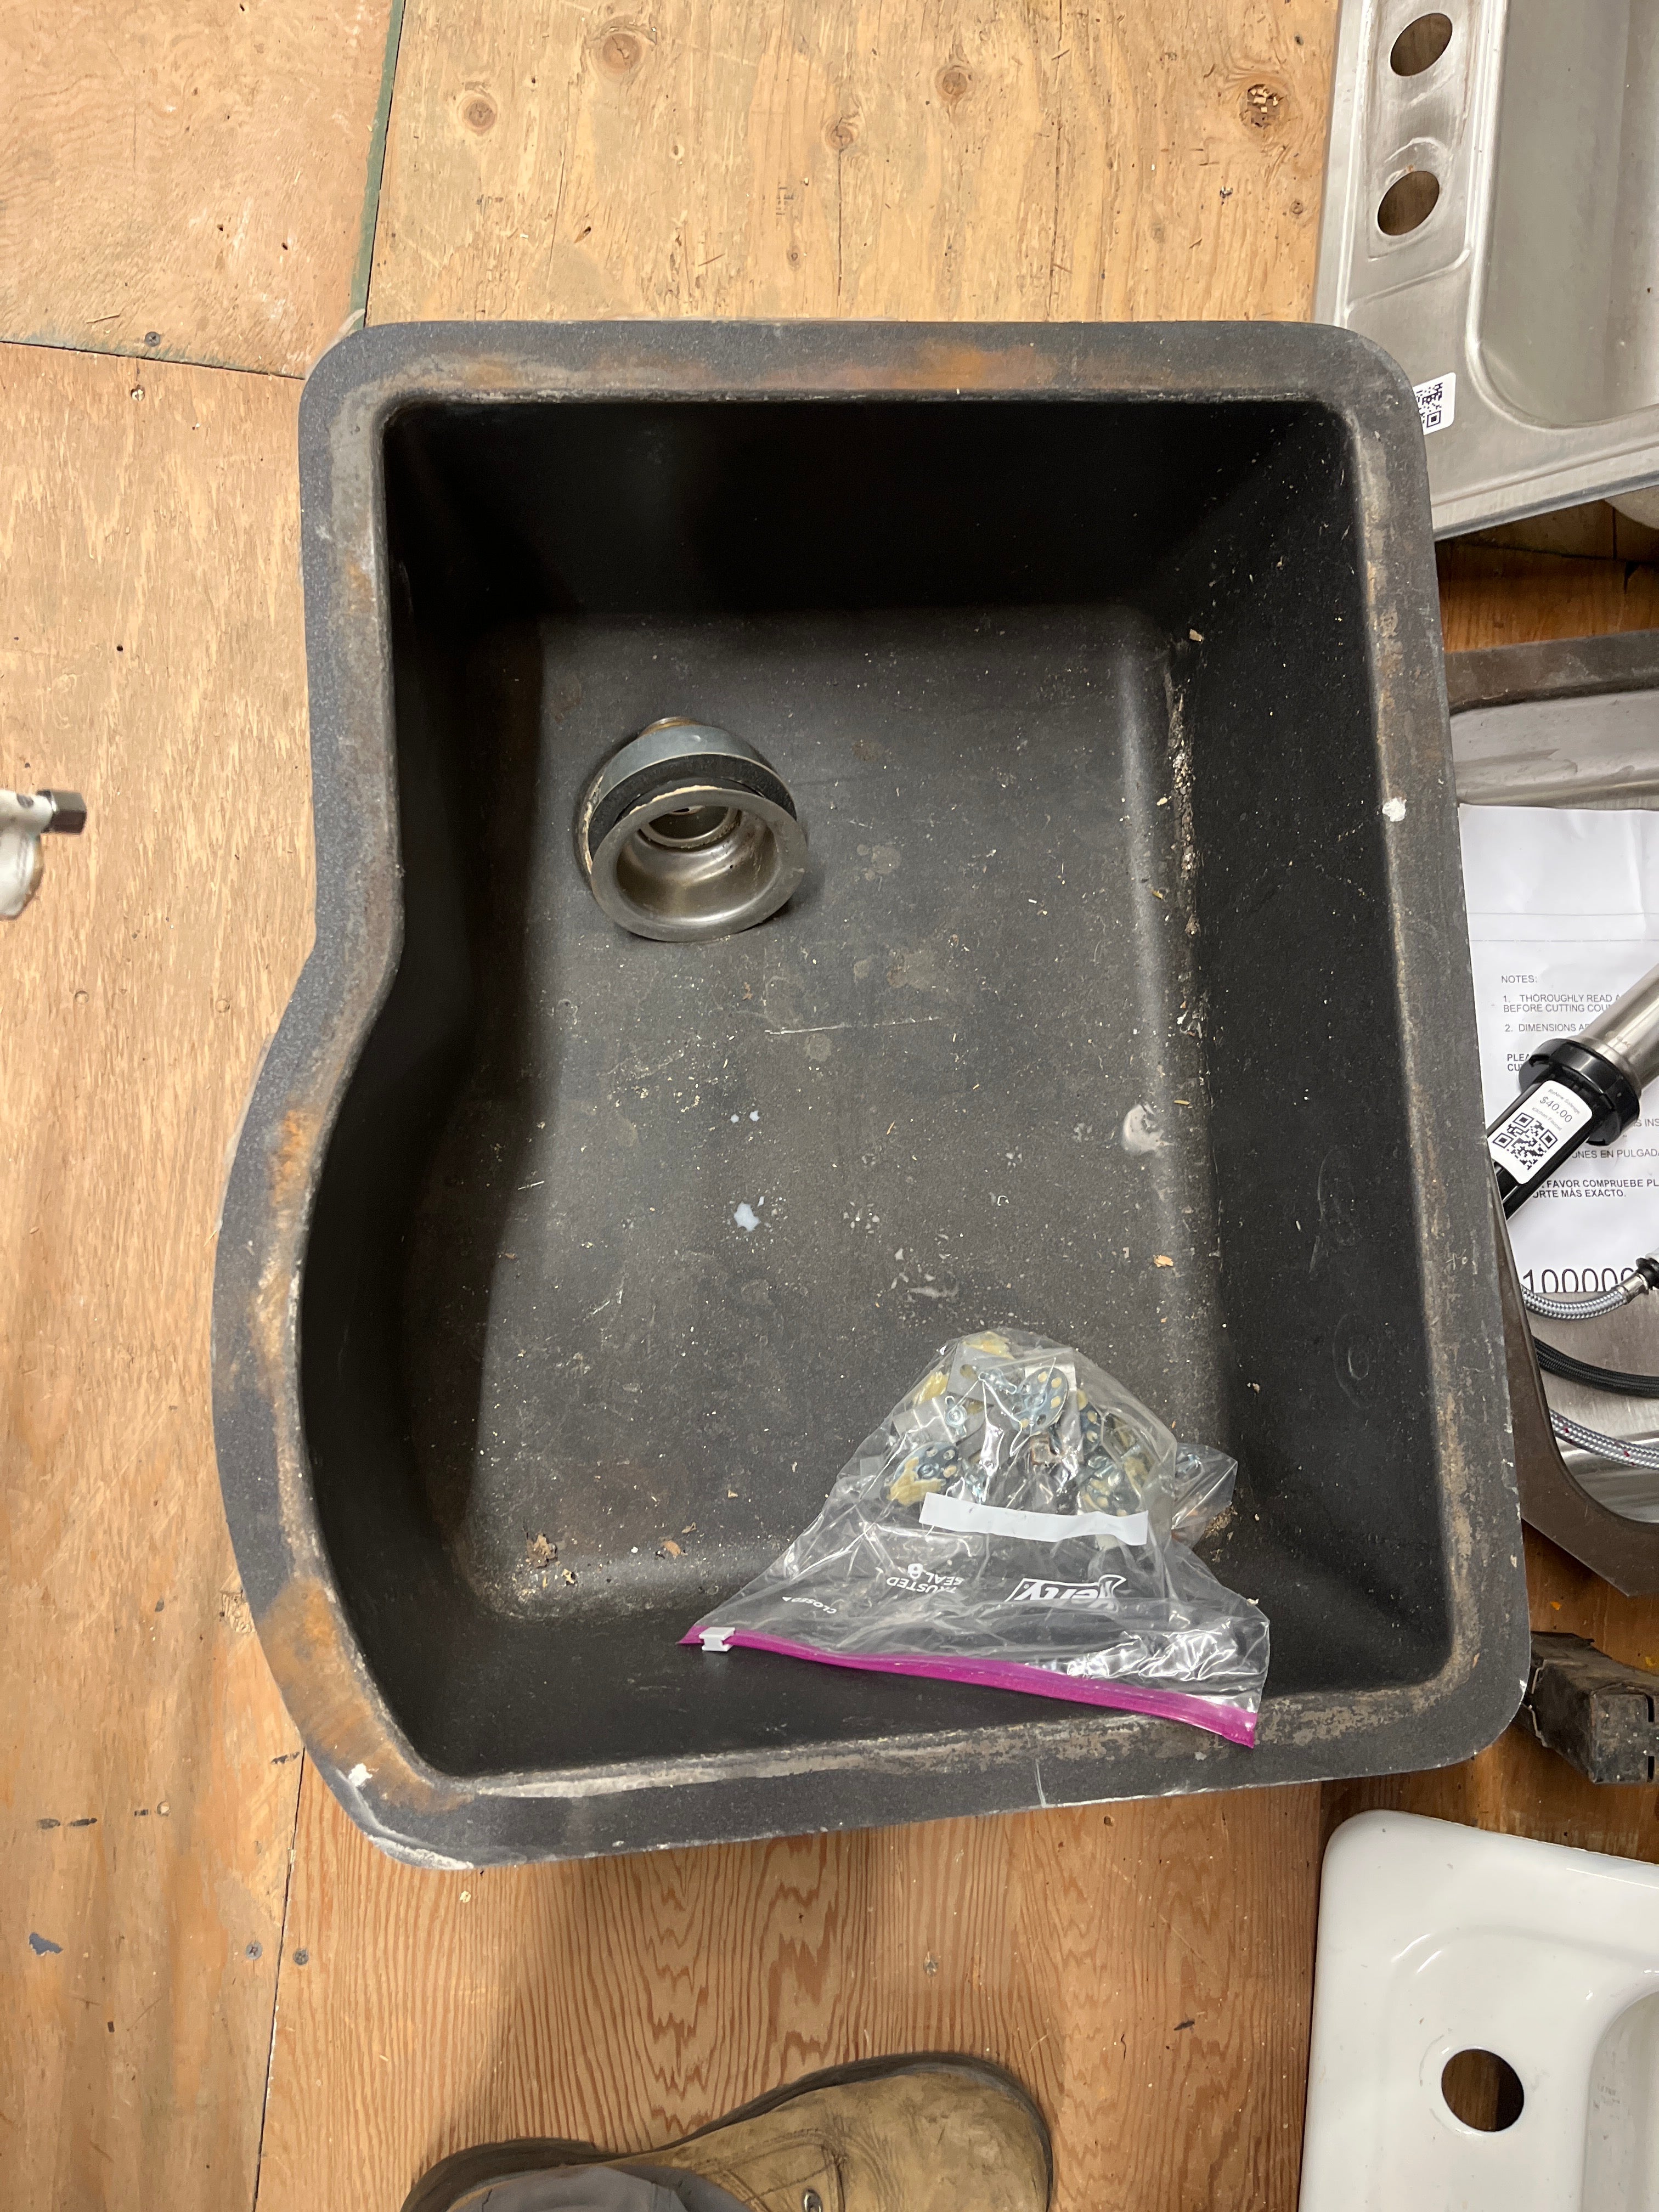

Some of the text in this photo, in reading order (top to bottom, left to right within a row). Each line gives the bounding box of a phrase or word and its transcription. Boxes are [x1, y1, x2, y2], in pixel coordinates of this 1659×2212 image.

[1501, 975, 1537, 983] NOTES:
[1520, 994, 1584, 1002] THOROUGHLY
[1587, 994, 1612, 1002] READ
[1503, 1004, 1610, 1013] BEFORE CUTTING COU
[1519, 1024, 1576, 1032] DIMENSIONS
[1507, 1063, 1523, 1071] CU
[1539, 1096, 1572, 1122] $40.00
[1600, 1150, 1614, 1158] EN
[1617, 1148, 1659, 1158] PULGAD
[1547, 1180, 1580, 1188] FAVOR
[1583, 1179, 1644, 1188] COMPRUEBE
[1561, 1187, 1582, 1197] MÁS
[1585, 1189, 1627, 1198] EXACTO.
[926, 1572, 964, 1586] SEAL
[886, 1577, 957, 1594] TRUSTED
[791, 1598, 837, 1614] CLOSED
